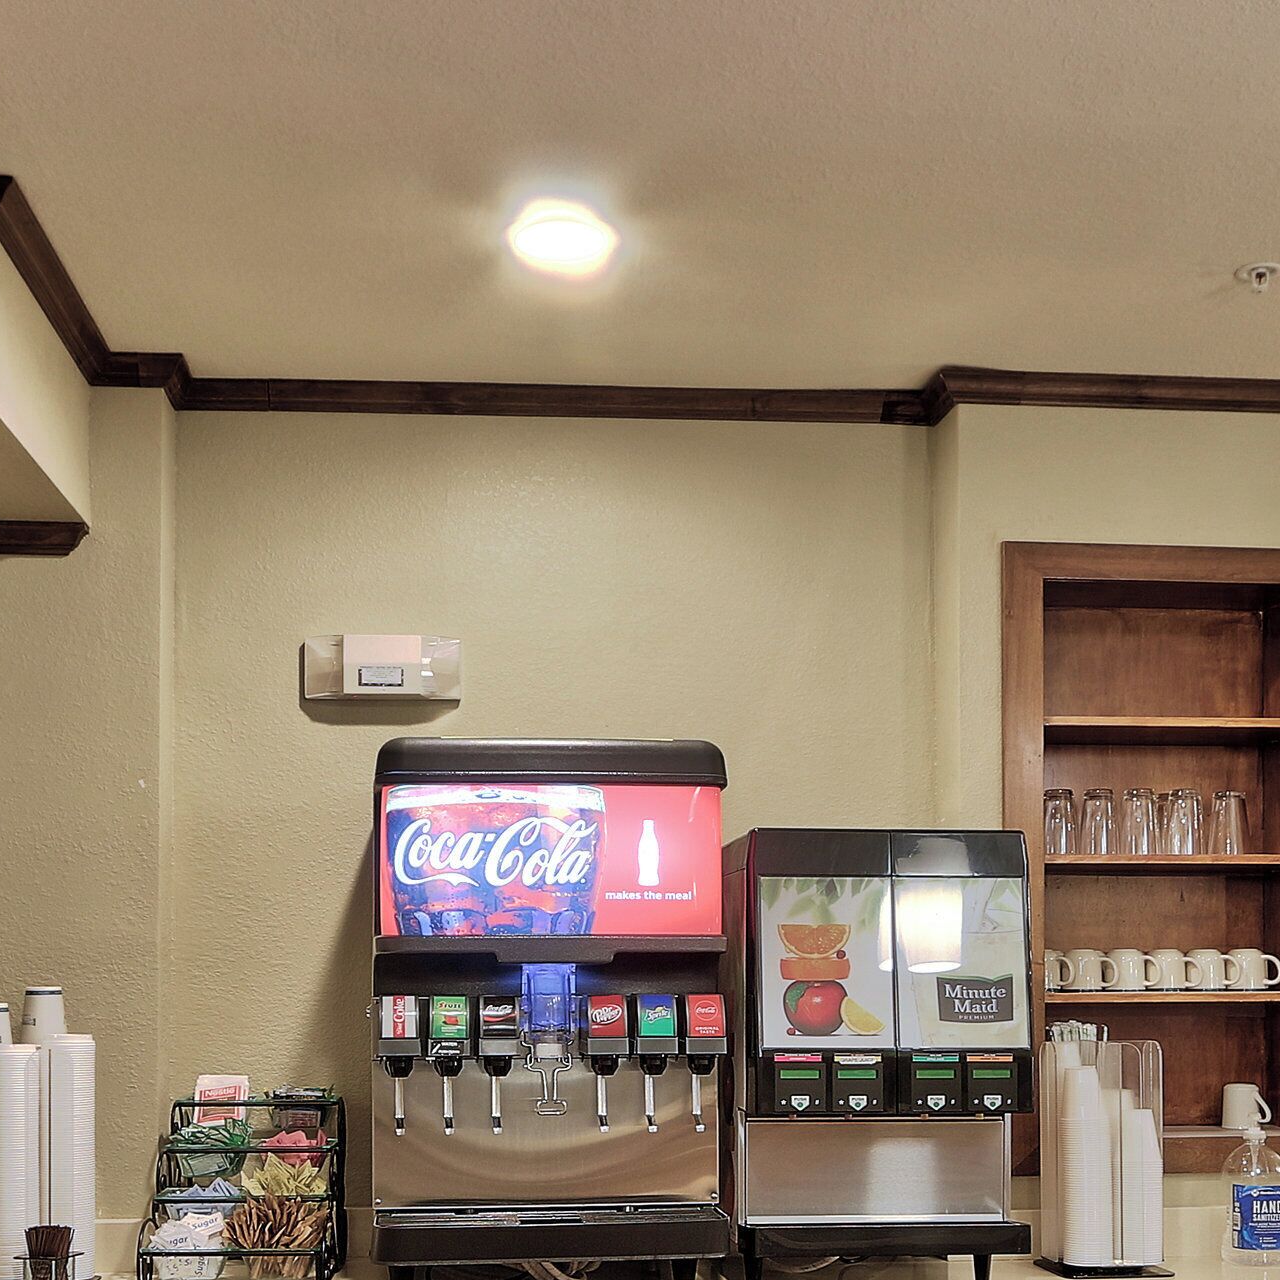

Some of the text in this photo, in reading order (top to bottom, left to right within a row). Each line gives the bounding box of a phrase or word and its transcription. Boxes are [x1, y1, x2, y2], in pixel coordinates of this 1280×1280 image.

[394, 817, 598, 887] Coca-Cola
[605, 891, 692, 900] makes the meal
[944, 983, 1007, 998] Minute
[393, 998, 405, 1022] Coke
[954, 999, 998, 1013] Maid
[192, 1216, 218, 1229] Sugar
